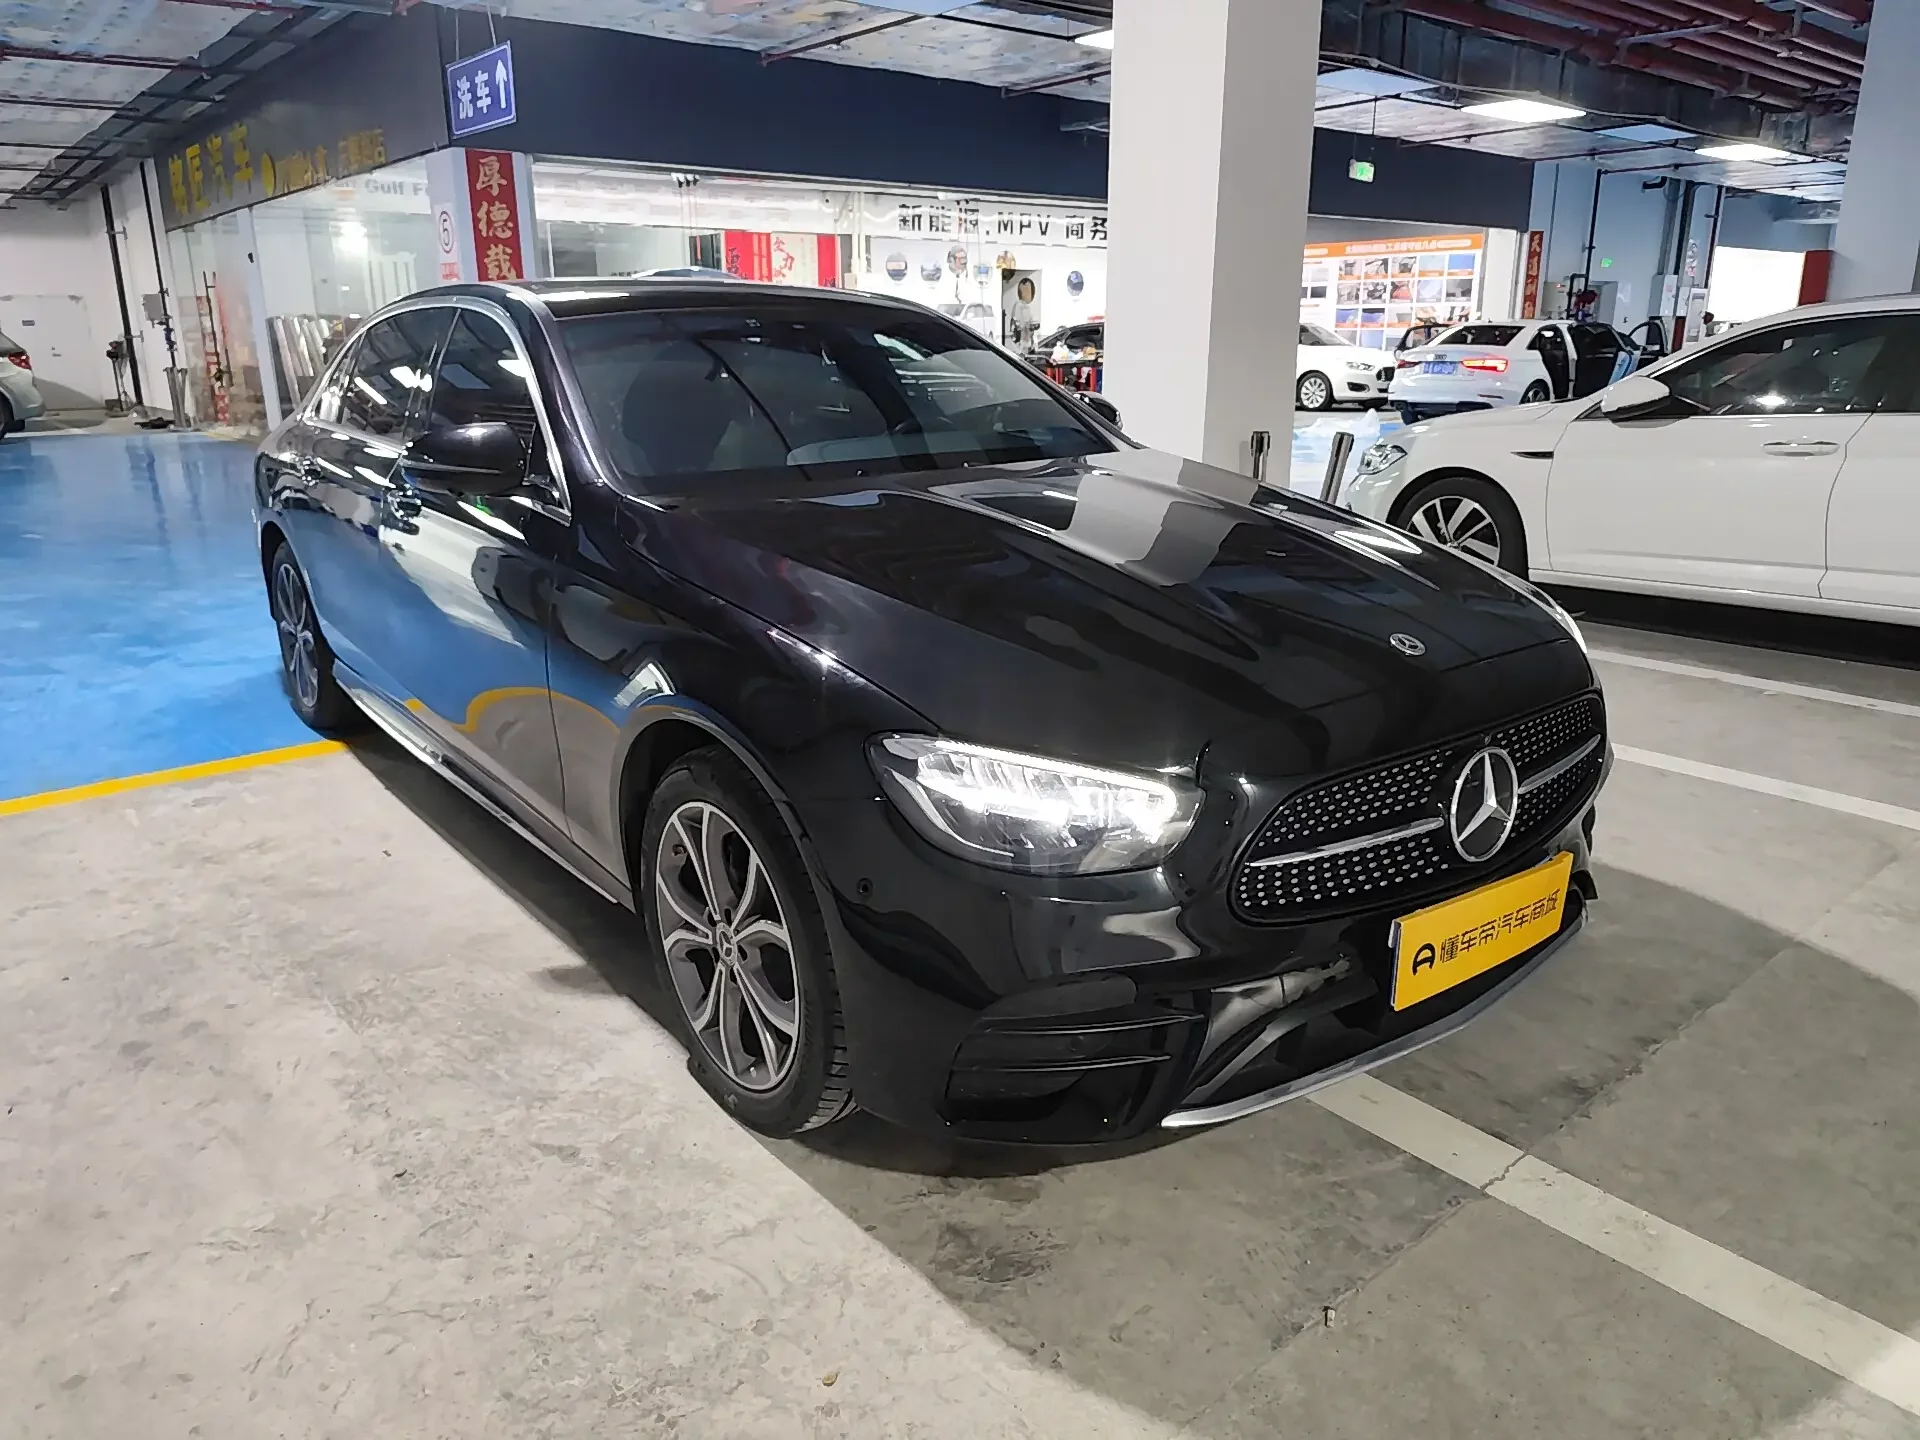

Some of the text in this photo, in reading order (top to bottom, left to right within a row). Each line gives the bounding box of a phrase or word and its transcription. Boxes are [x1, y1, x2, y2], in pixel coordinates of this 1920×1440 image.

[456, 69, 492, 120] 洗车
[475, 154, 517, 281] 厚德载
[1439, 887, 1560, 963] 懂车帝汽车商城
